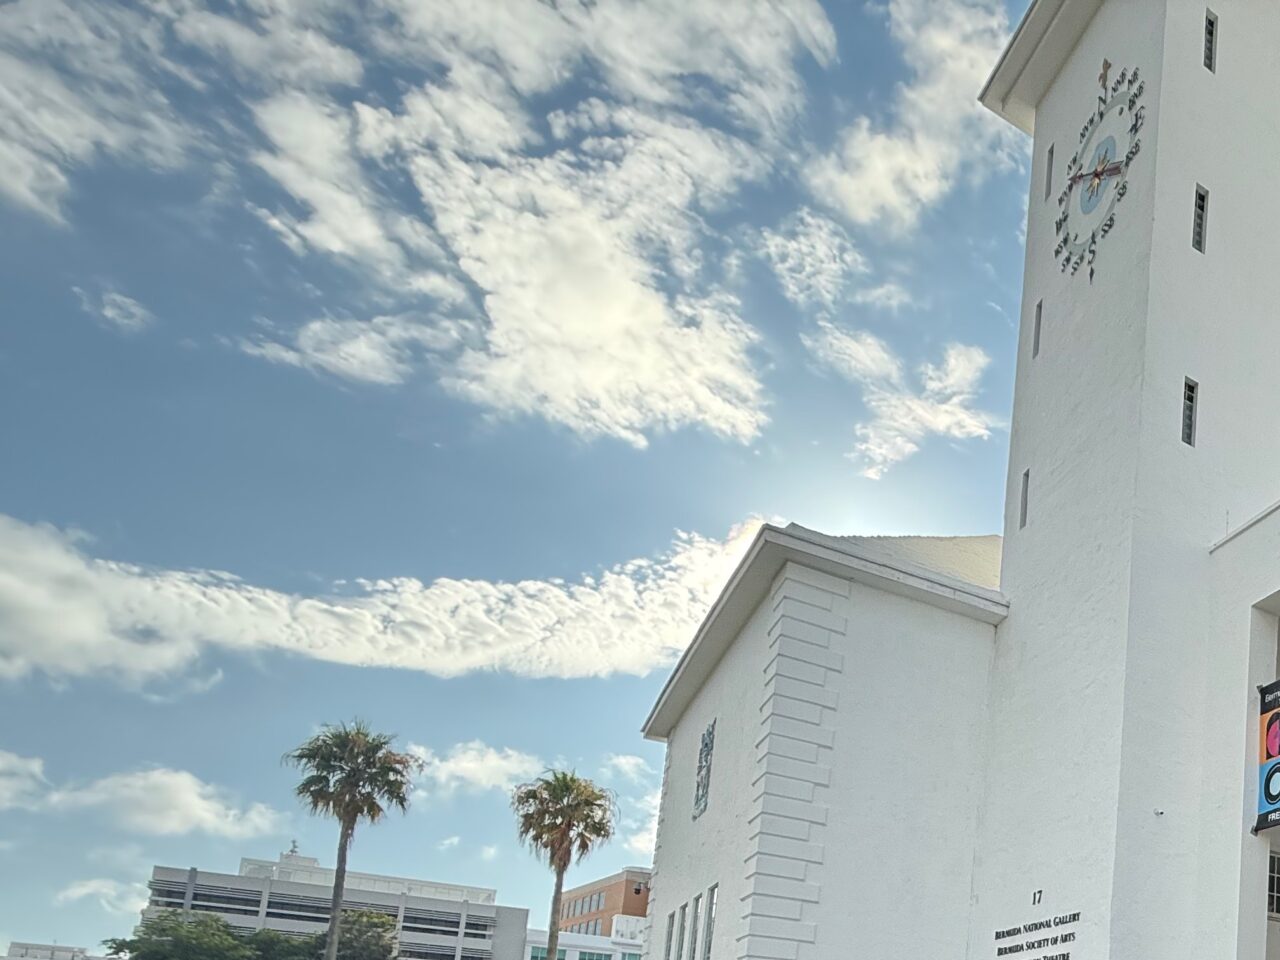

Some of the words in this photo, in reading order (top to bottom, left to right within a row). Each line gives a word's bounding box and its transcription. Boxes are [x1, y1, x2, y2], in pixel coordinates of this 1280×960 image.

[1032, 889, 1043, 905] 17
[995, 926, 1021, 940] BERMUDA
[1022, 919, 1052, 934] NATIONAL
[1053, 911, 1081, 927] GALLERY
[997, 944, 1024, 956] BERMUDA
[1025, 937, 1050, 951] SOCIETY
[1050, 936, 1059, 946] OF
[1060, 932, 1076, 944] ARTS
